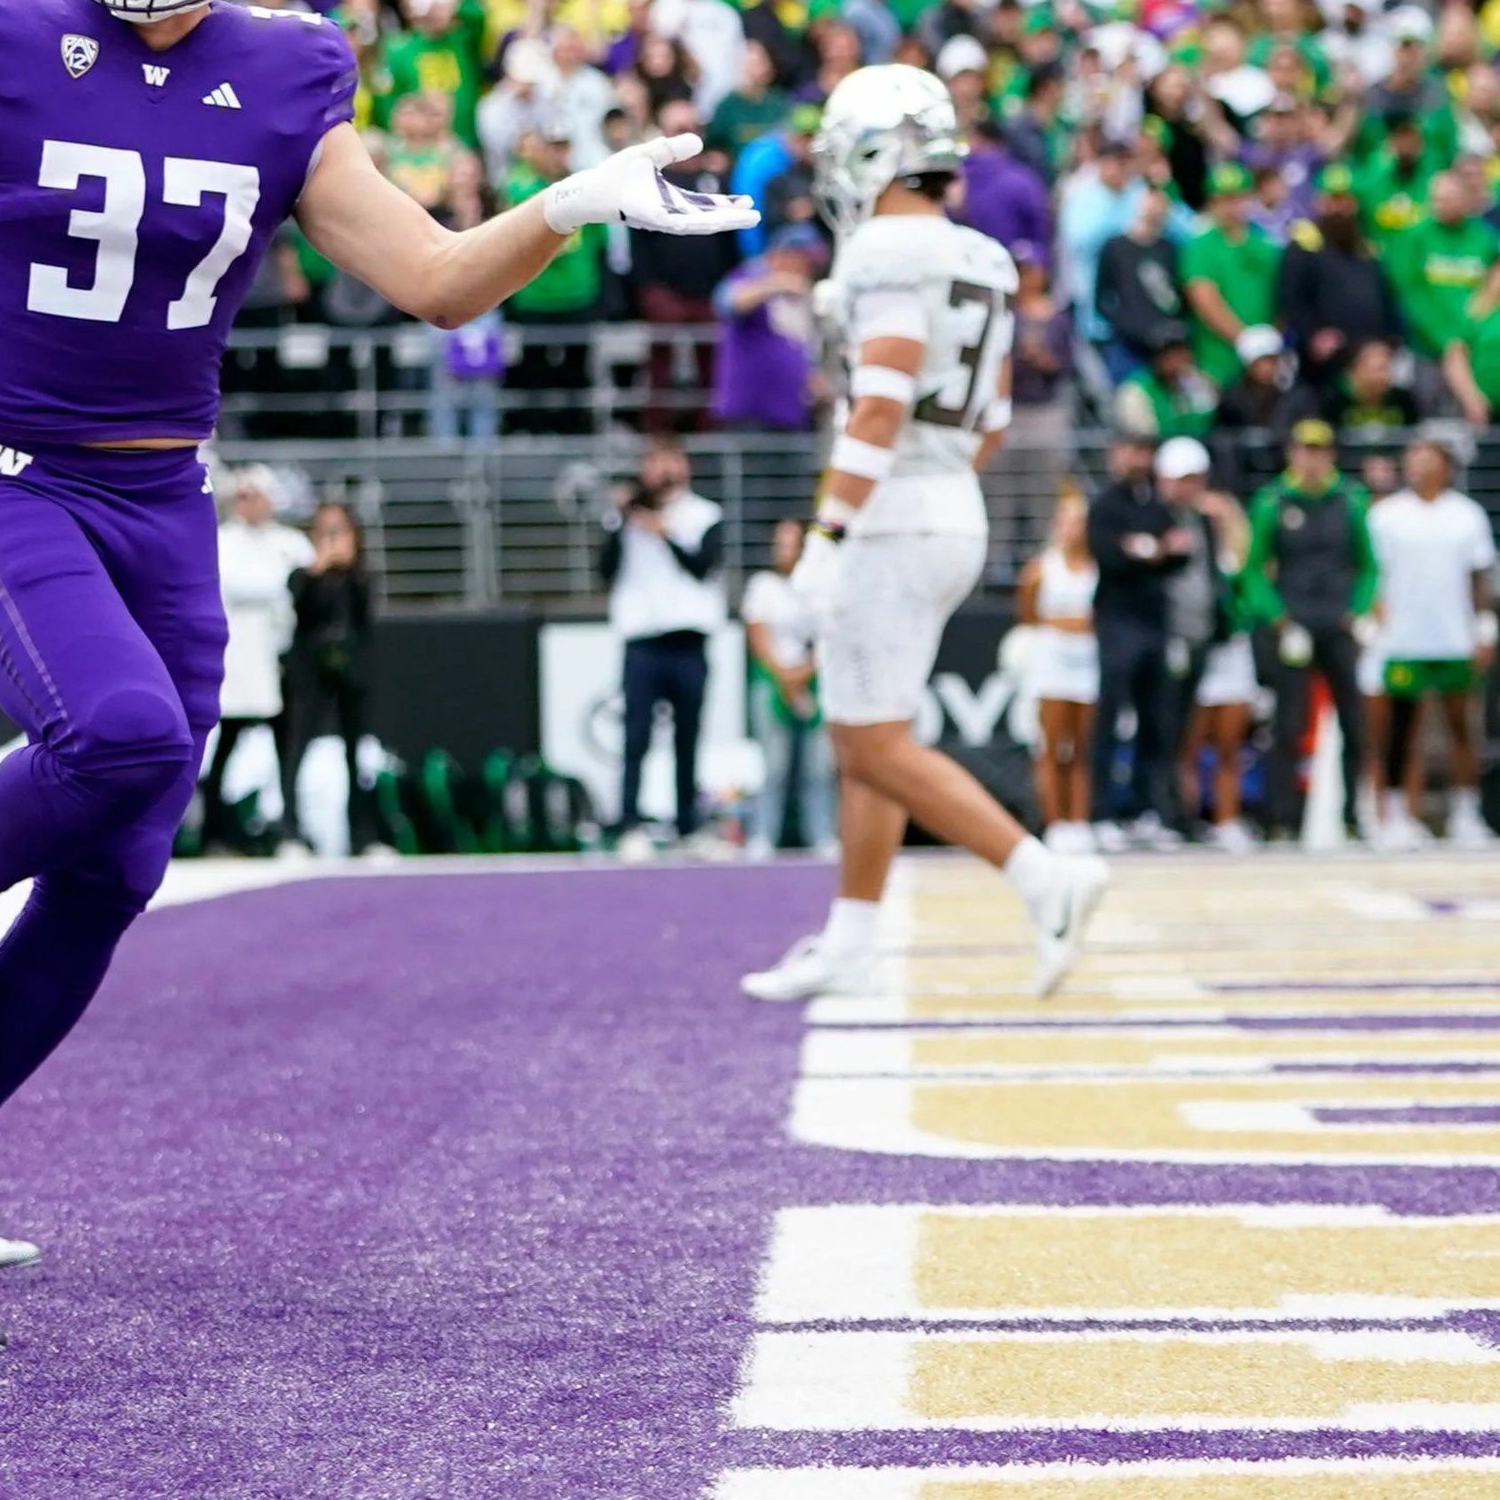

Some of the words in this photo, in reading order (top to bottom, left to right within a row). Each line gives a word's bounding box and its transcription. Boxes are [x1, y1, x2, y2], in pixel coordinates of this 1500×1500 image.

[64, 36, 97, 64] PAC
[69, 52, 87, 70] 12
[141, 63, 171, 87] W
[27, 139, 261, 331] 37
